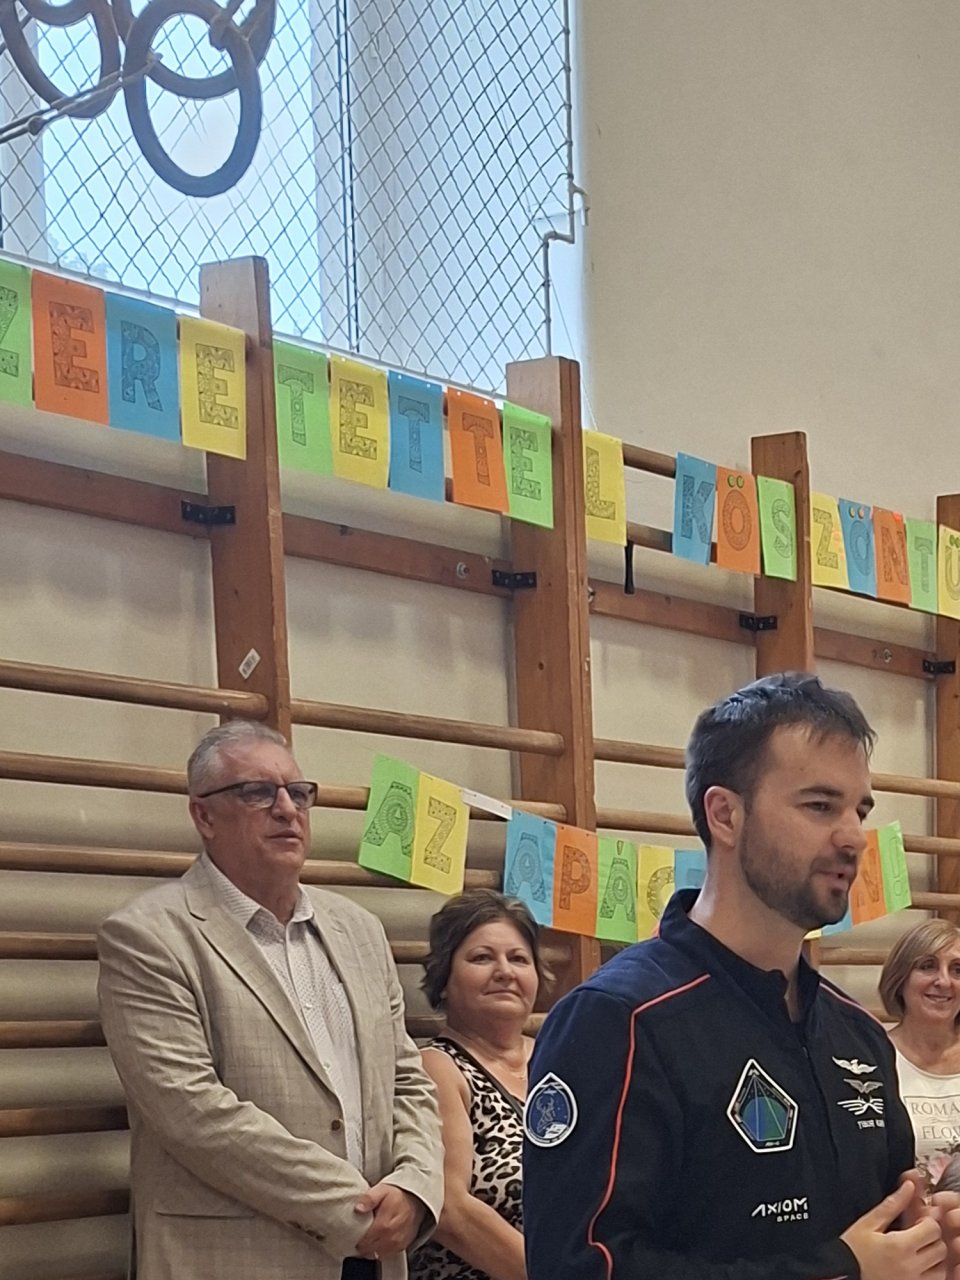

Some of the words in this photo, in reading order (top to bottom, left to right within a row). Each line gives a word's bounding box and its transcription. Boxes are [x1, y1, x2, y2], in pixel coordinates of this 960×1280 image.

[362, 780, 457, 875] AZ
[751, 1197, 808, 1217] AXIOM
[776, 1212, 808, 1222] SPACE
